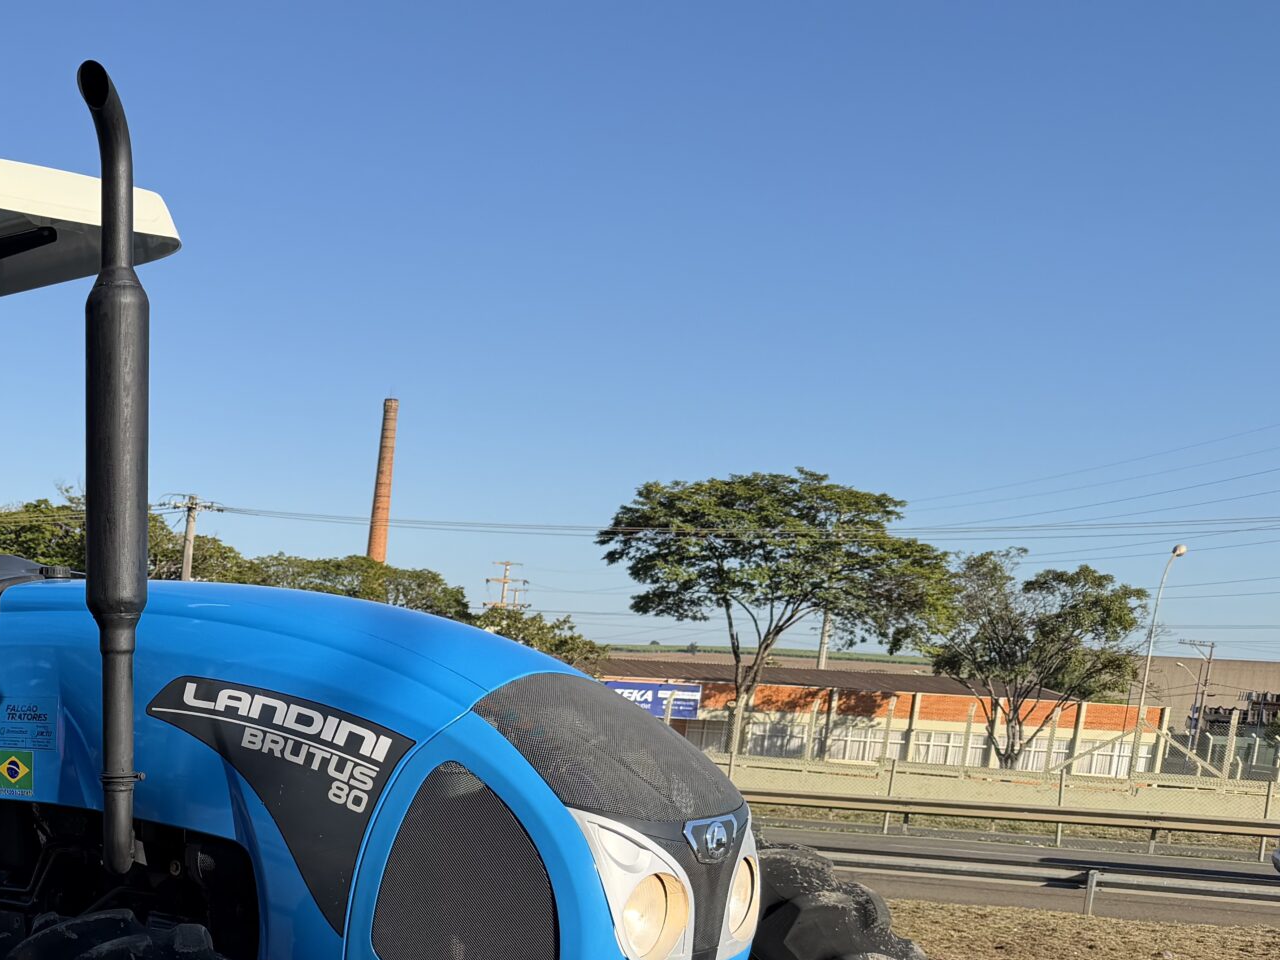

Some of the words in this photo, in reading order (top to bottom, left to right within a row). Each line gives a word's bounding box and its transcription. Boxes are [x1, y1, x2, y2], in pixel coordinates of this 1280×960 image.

[7, 713, 48, 722] TRATORES
[183, 682, 392, 763] LANDINI
[241, 727, 379, 791] BRUTUS
[328, 781, 369, 813] 80
